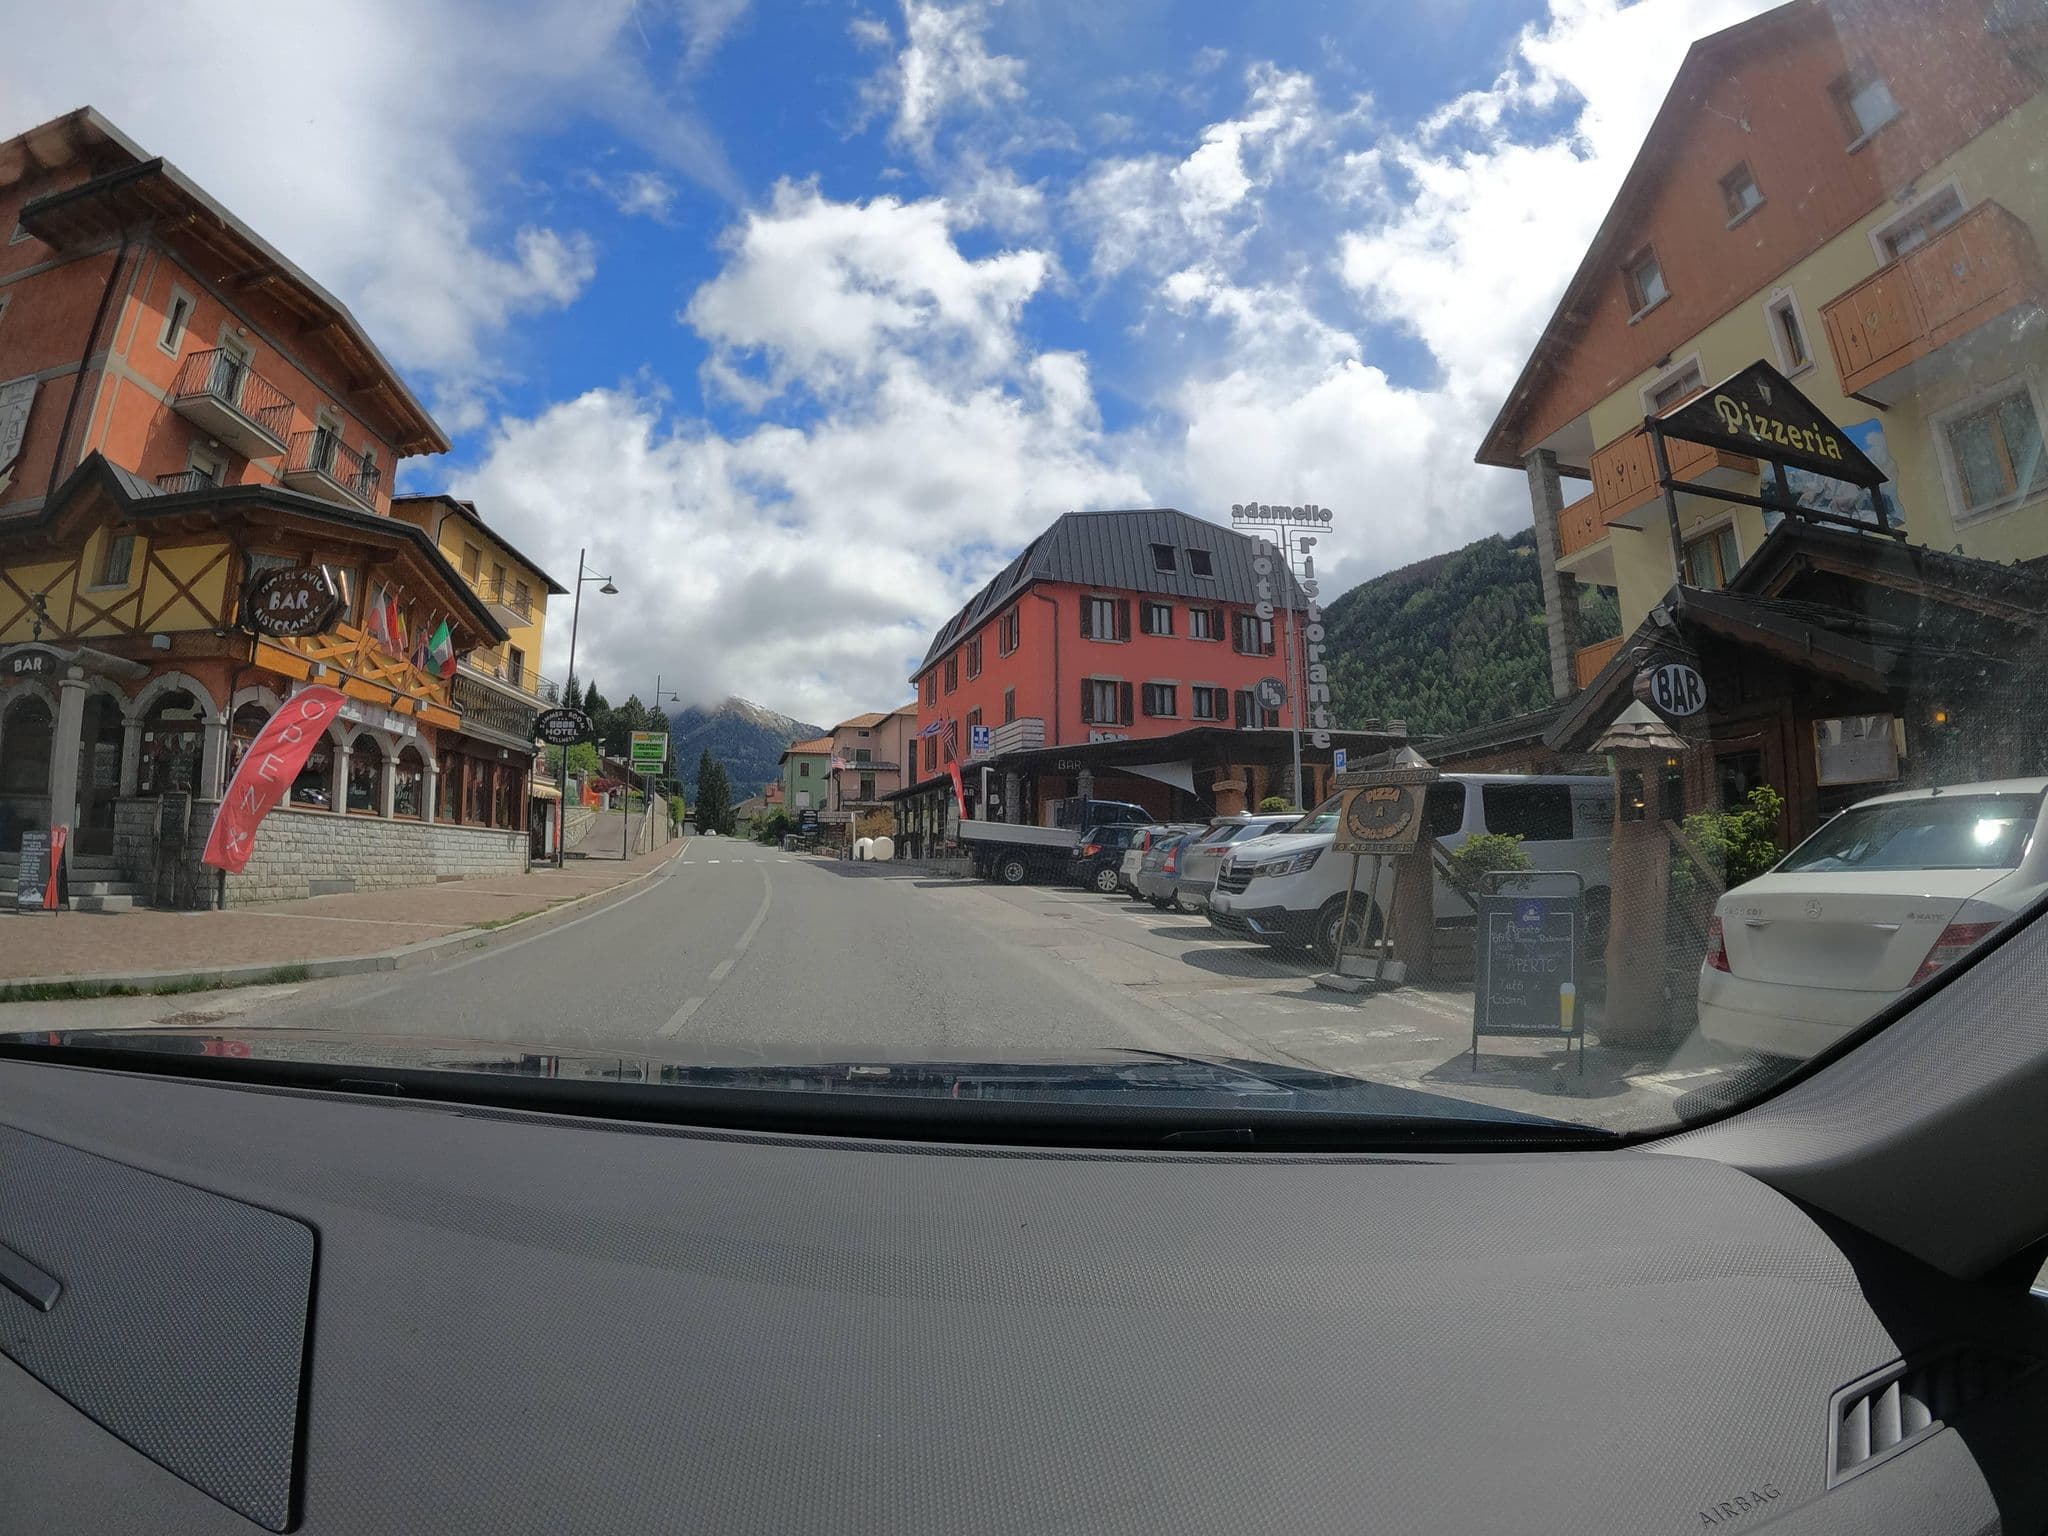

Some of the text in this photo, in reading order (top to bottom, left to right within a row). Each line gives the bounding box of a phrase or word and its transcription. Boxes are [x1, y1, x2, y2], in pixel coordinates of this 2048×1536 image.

[1714, 394, 1843, 461] Pizzeria
[1231, 502, 1333, 522] adamello
[268, 589, 309, 610] BAR
[1250, 534, 1274, 644] hotel
[255, 605, 320, 631] RISTORANTE
[1299, 535, 1331, 749] ristorante
[14, 657, 42, 673] BAR
[1657, 668, 1702, 712] BAR
[545, 728, 579, 736] HOTEL
[240, 699, 326, 815] OPEN
[1058, 760, 1082, 770] BAR
[1699, 1483, 1782, 1529] AIRBAG
